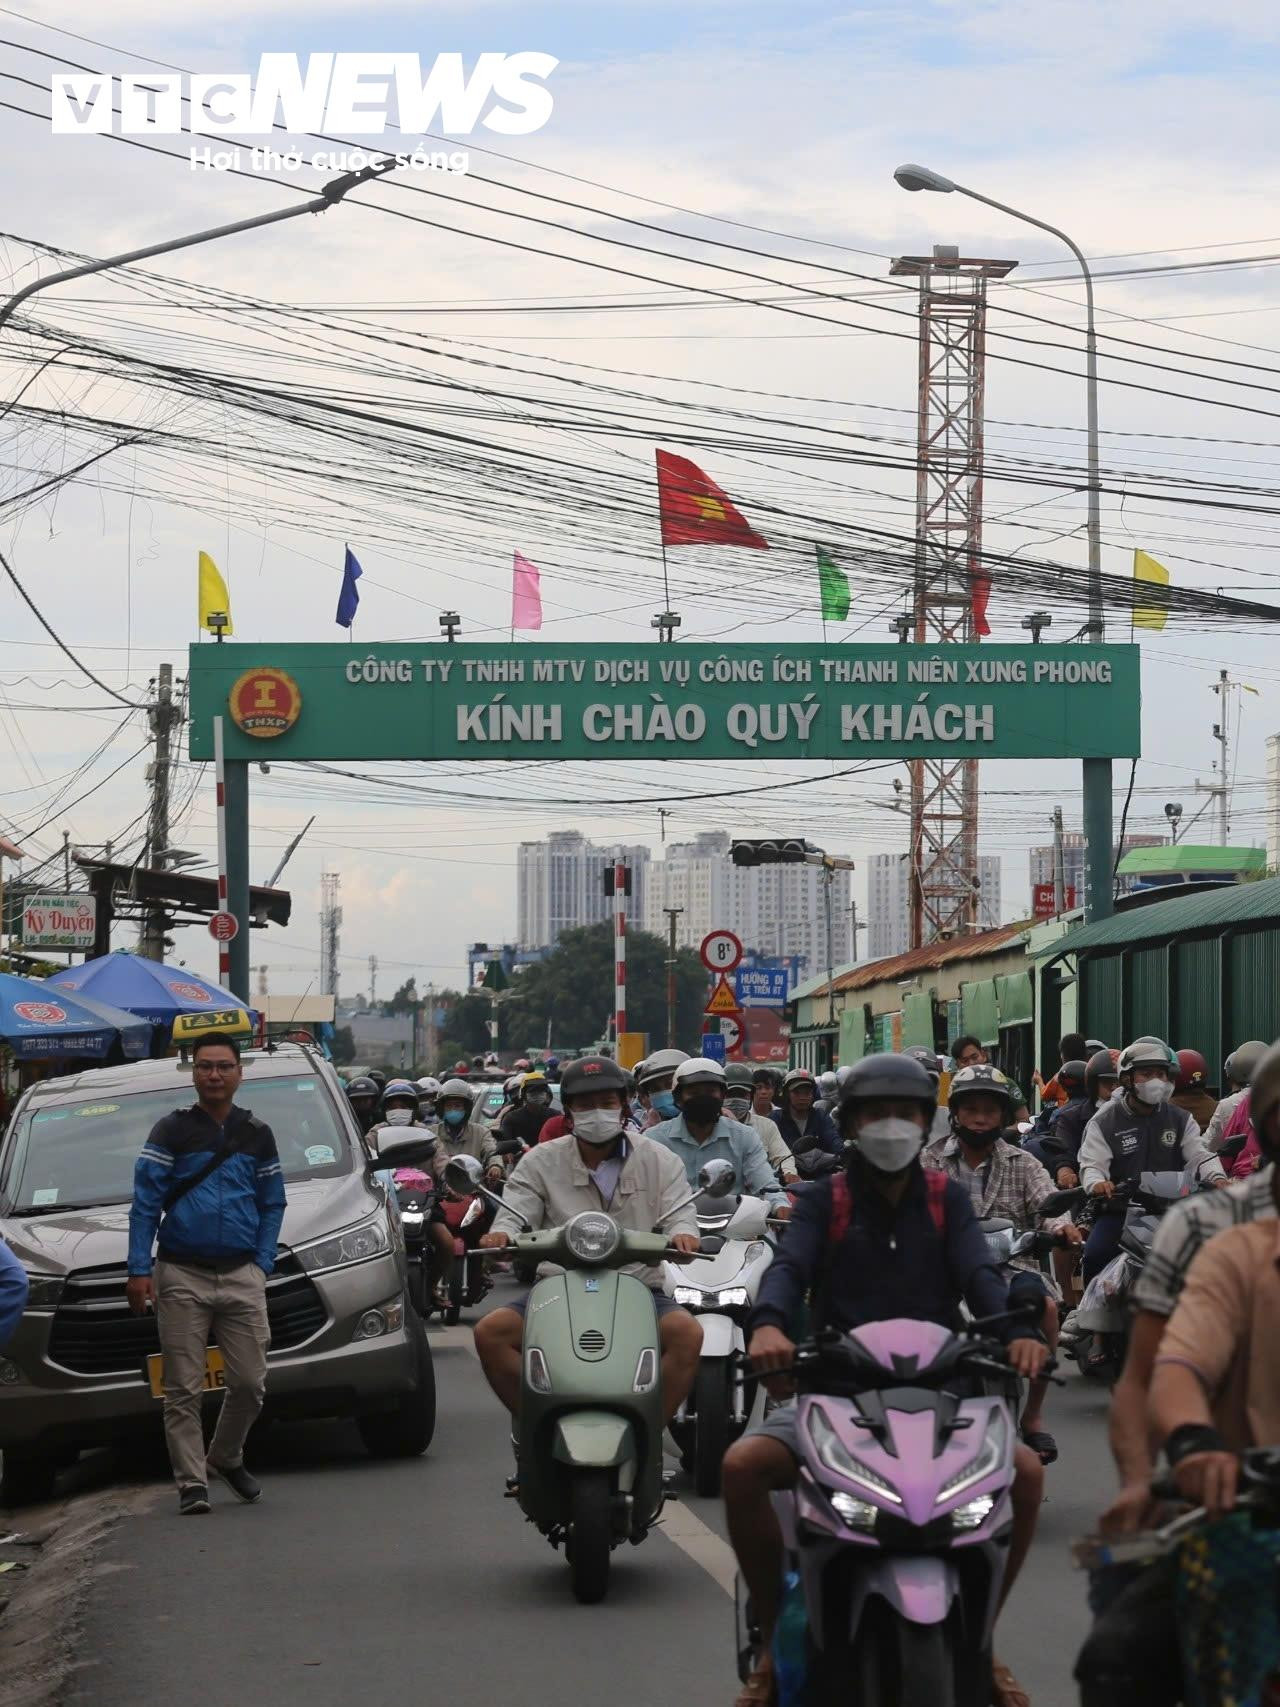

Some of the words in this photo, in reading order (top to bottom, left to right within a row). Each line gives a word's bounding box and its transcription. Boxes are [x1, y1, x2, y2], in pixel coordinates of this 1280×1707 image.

[346, 655, 413, 682] CÔNG
[422, 659, 454, 682] TY
[461, 660, 522, 682] TNHH
[532, 660, 586, 682] MTV
[594, 660, 650, 689] DỊCH
[660, 660, 691, 689] VỤ
[699, 654, 764, 683] CÔNG
[772, 653, 812, 683] ÍCH
[820, 659, 898, 683] THANH
[907, 655, 959, 683] NIÊN
[965, 660, 1028, 683] XUNG
[1033, 660, 1113, 684] PHONG
[456, 693, 563, 743] KÍNH
[582, 693, 707, 743] CHÀO
[726, 692, 822, 748] QUÝ
[840, 692, 995, 743] KHÁCH
[216, 915, 230, 939] STOP
